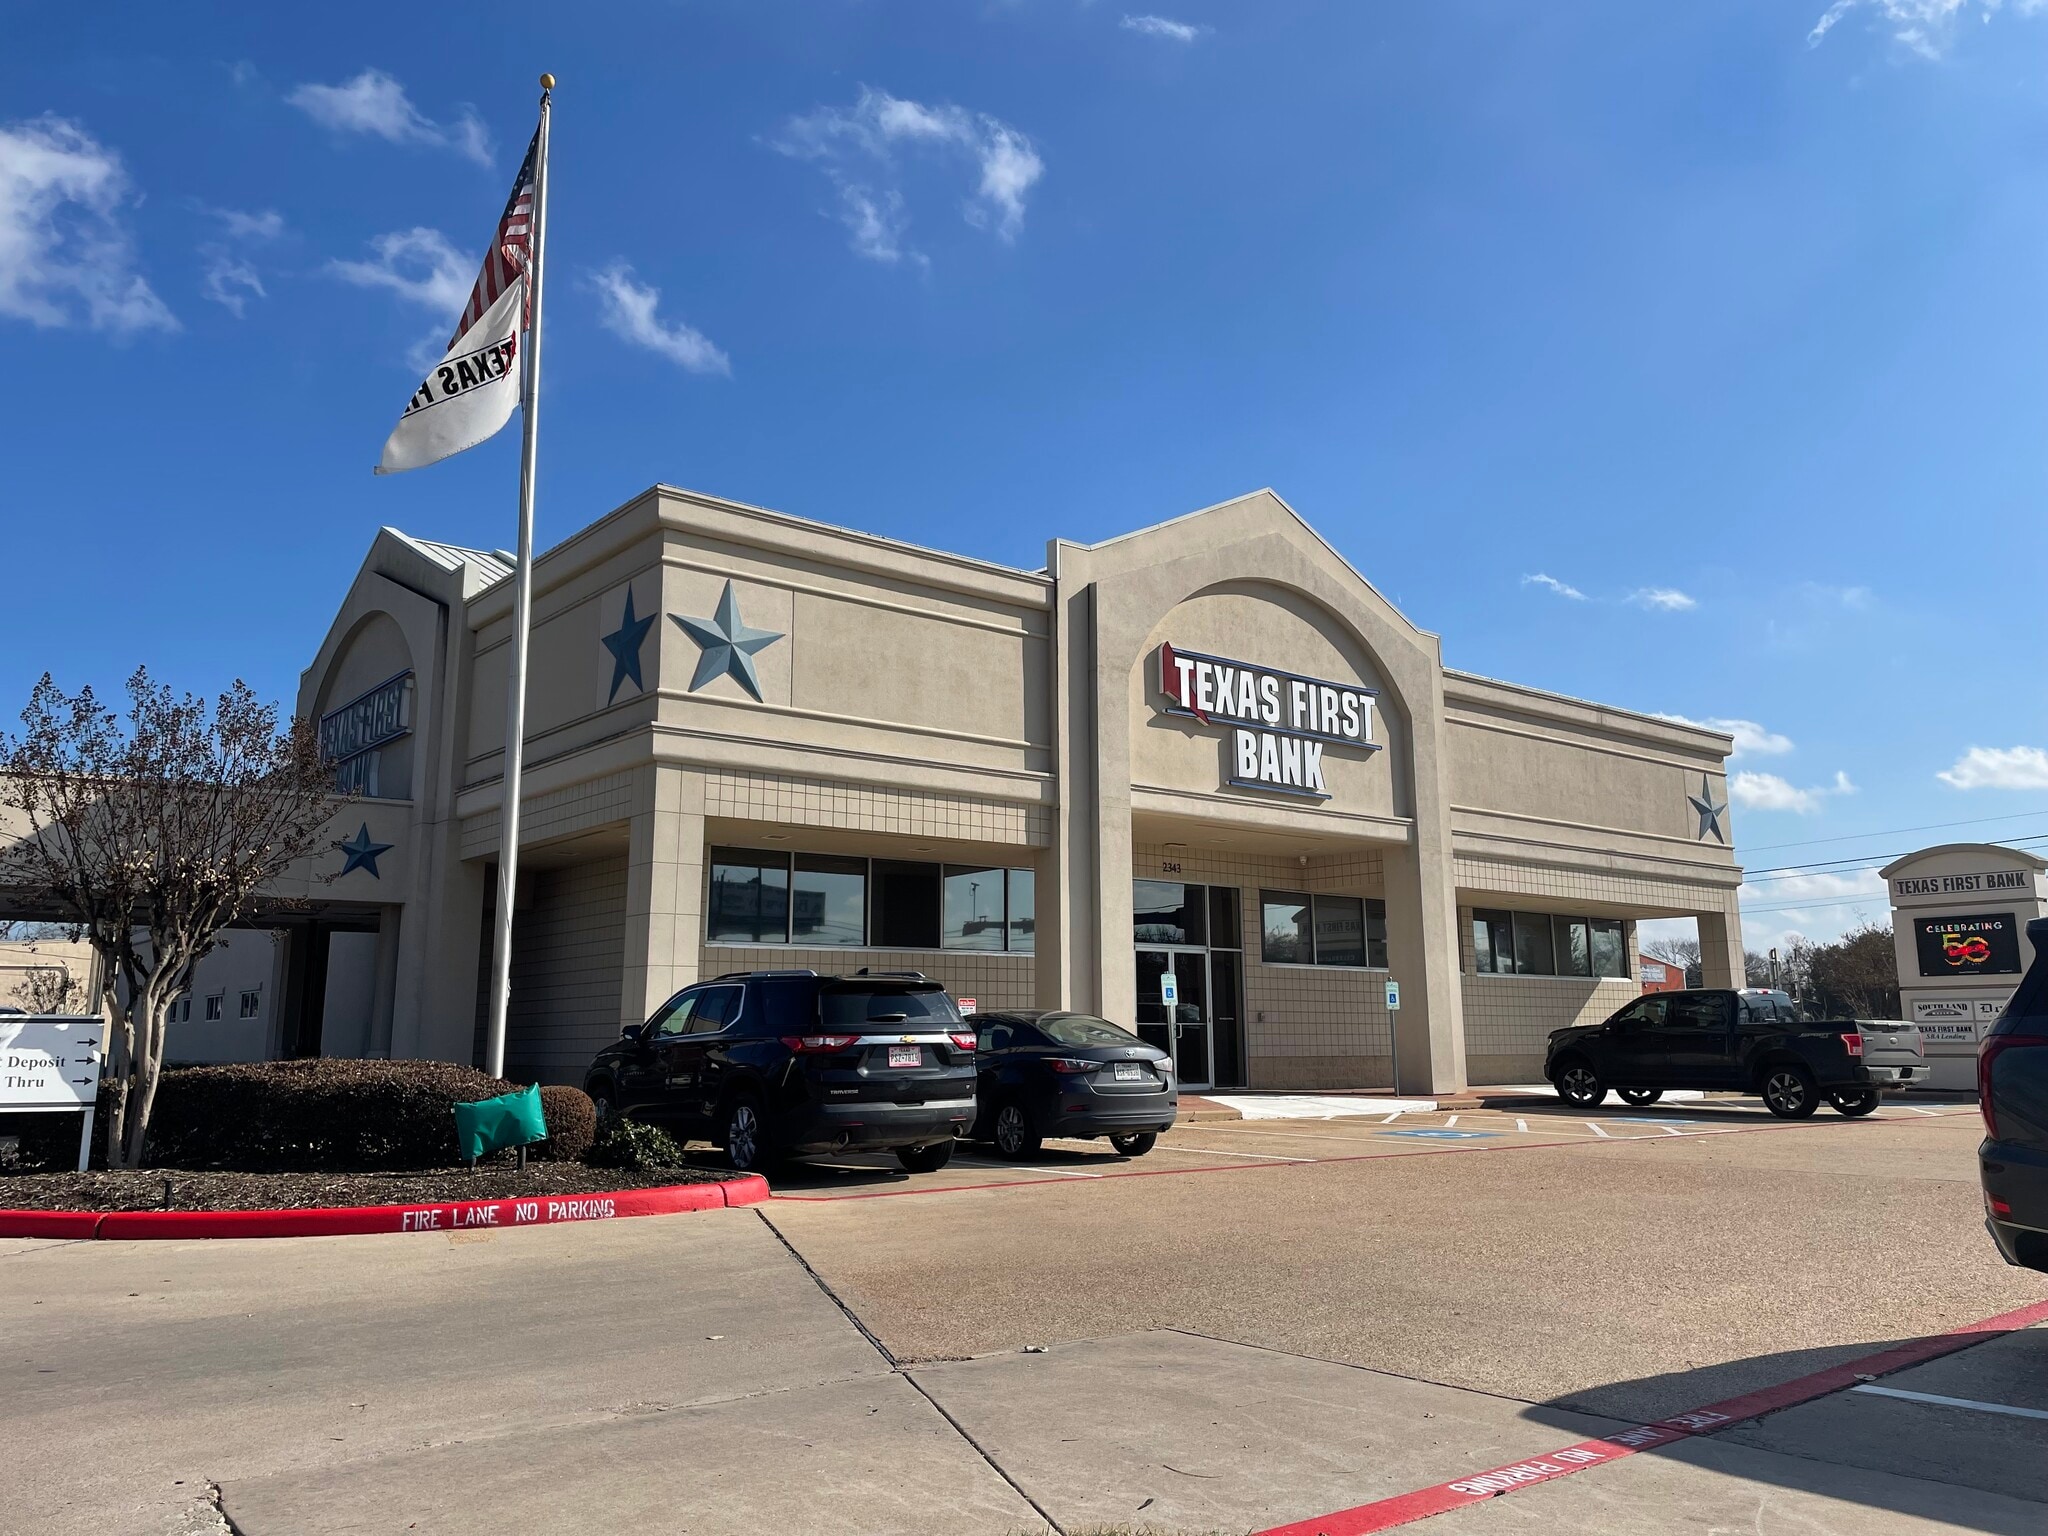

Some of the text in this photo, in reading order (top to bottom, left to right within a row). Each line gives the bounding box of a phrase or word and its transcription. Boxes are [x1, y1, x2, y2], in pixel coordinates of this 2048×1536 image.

[1174, 656, 1376, 740] TEXAS FIRST
[1235, 728, 1325, 789] BANK
[1163, 862, 1181, 873] 2343
[1897, 872, 2026, 894] TEXAS FIRST BANK
[1926, 921, 2003, 933] CELEBRATING
[1942, 933, 1991, 966] 50
[1937, 1025, 1954, 1033] FIRST
[1956, 1025, 1973, 1033] BANK
[8, 1056, 66, 1071] Deposit
[5, 1076, 44, 1088] Thru
[402, 1198, 615, 1231] FIRE LANE NO PARKING
[1551, 1447, 1605, 1464] NO
[1448, 1460, 1564, 1496] PARKING
